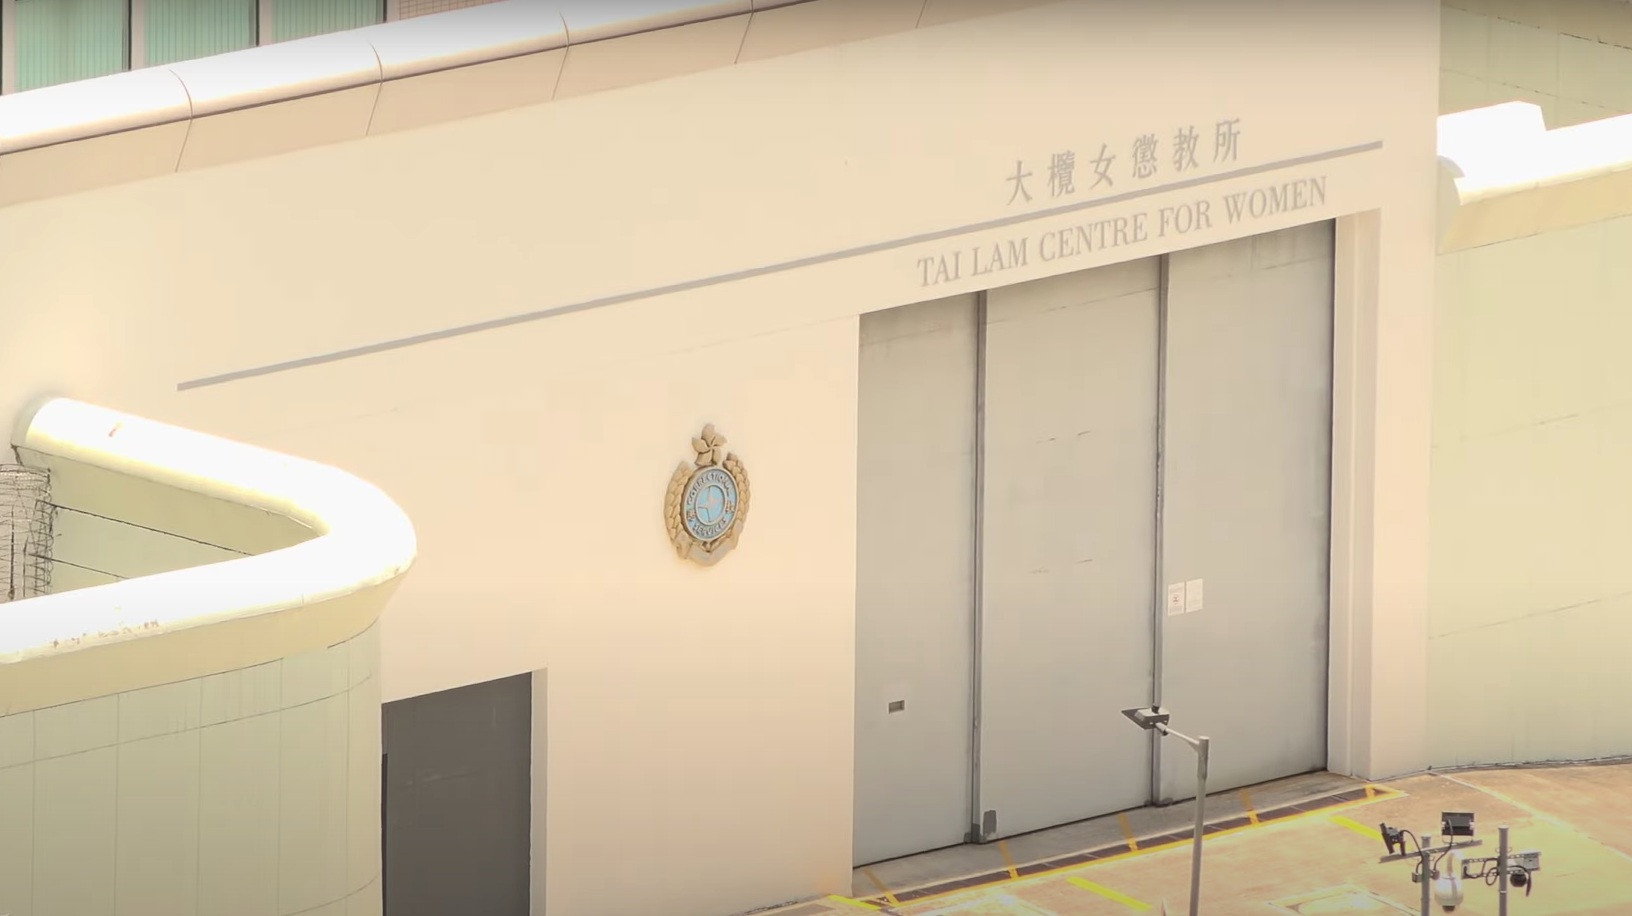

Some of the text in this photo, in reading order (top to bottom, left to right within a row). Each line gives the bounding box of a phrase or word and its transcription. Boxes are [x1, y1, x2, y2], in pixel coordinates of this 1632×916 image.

[1005, 117, 1241, 206] 大欖女懲教所
[916, 176, 1328, 288] TAI LAM CENTRE FOR WOMEN
